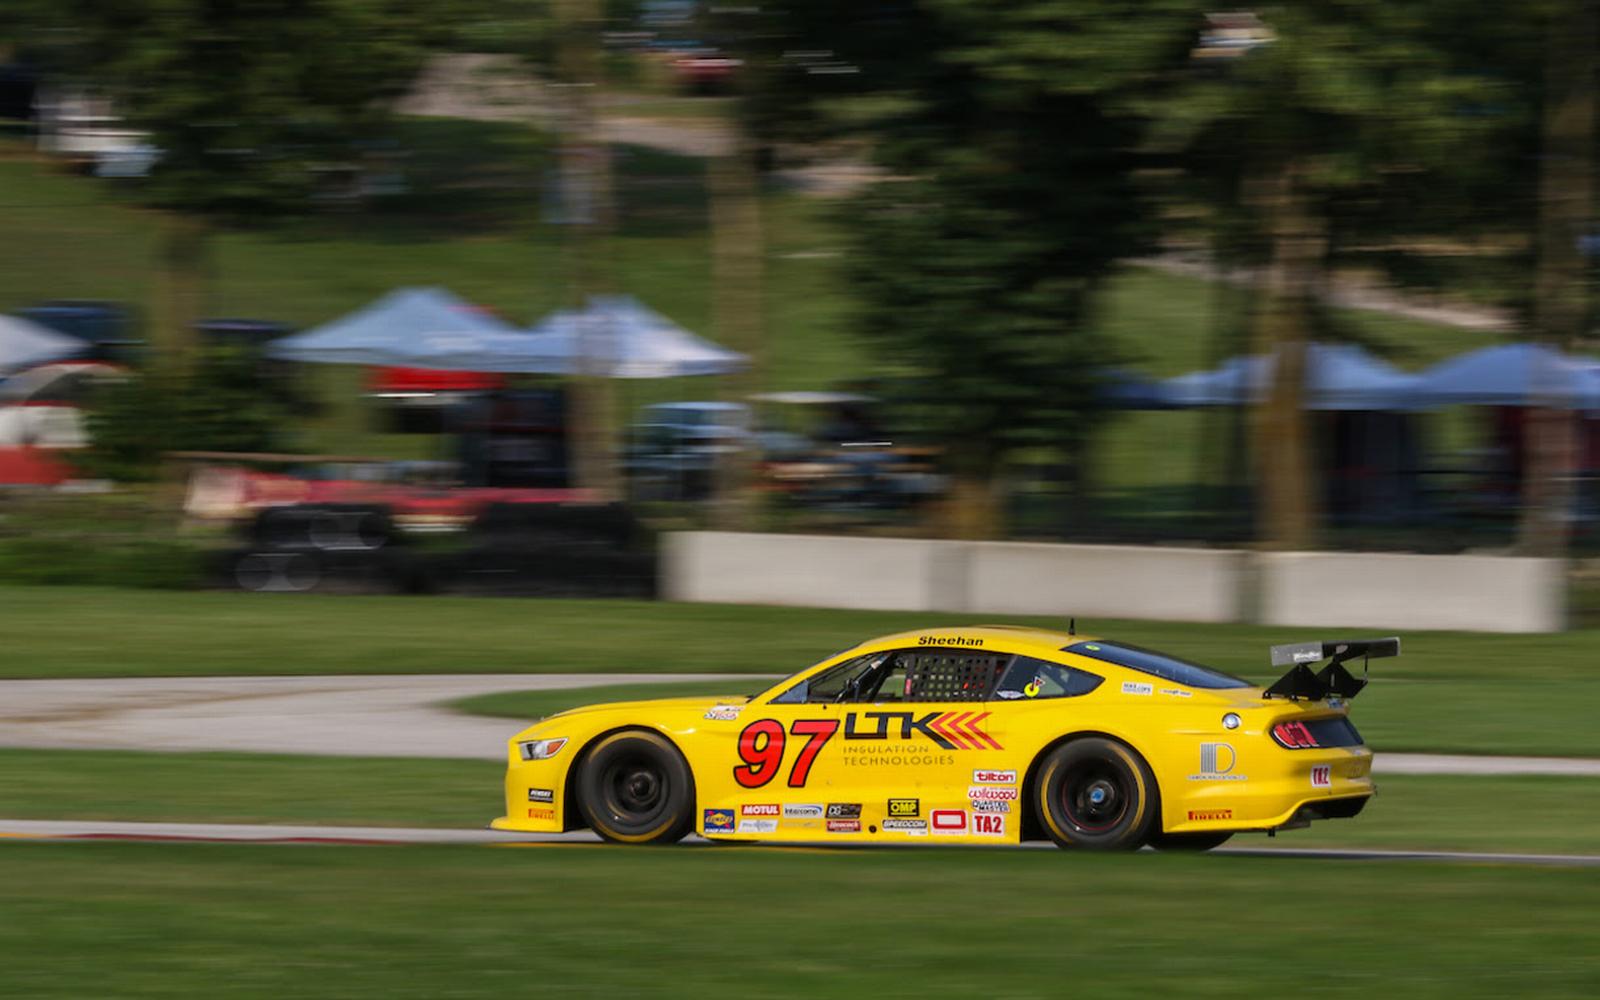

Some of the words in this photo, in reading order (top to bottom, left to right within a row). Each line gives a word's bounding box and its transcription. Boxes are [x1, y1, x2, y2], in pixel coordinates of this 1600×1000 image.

[918, 636, 984, 646] Sheehan
[844, 712, 958, 750] LTK
[733, 718, 840, 789] 97
[843, 745, 929, 754] INSULATION
[843, 756, 955, 766] TECHNOLOGIES
[977, 772, 1014, 781] tilton
[968, 788, 1018, 800] wilwood
[743, 805, 779, 815] MOTUL
[785, 807, 818, 816] Intercomp
[891, 802, 917, 813] OMP
[1188, 810, 1232, 820] PIRELLI
[974, 815, 1002, 833] TA2
